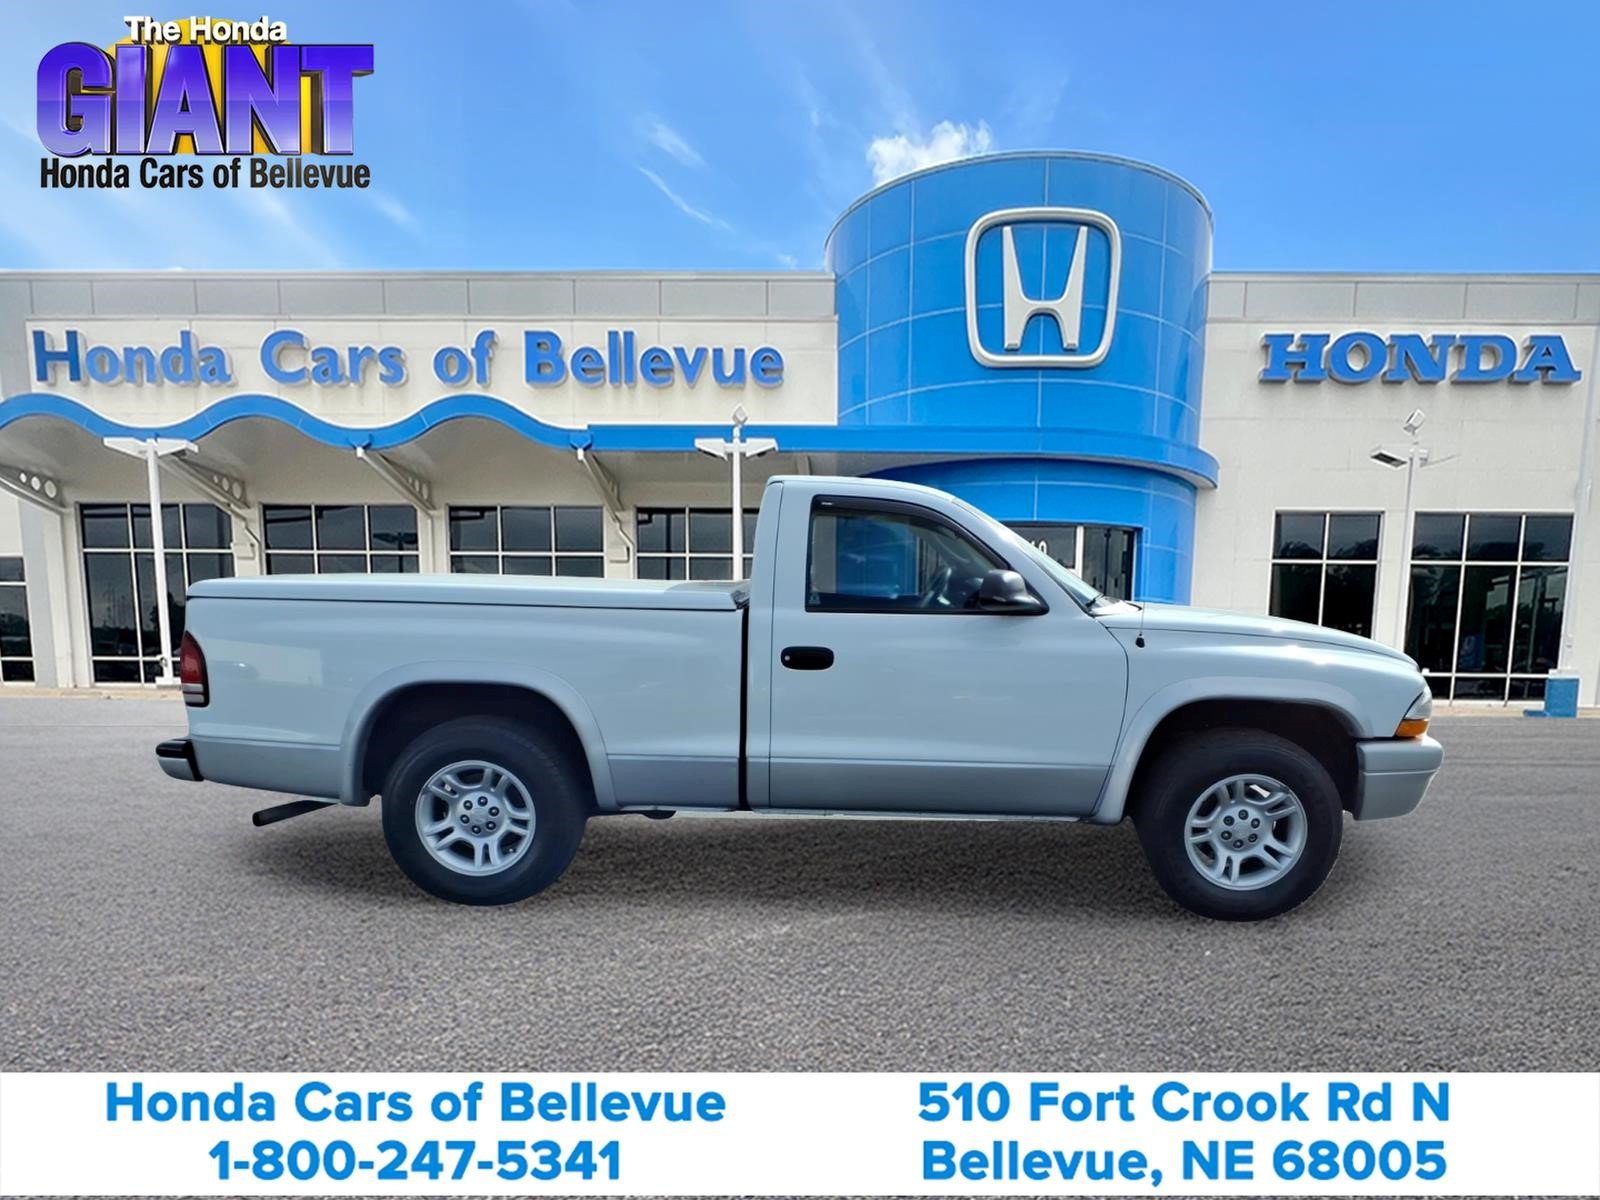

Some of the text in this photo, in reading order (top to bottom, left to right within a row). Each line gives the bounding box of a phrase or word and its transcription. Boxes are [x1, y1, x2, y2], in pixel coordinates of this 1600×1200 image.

[34, 330, 784, 387] Honda Cars of Bellevue
[1260, 331, 1582, 383] HONDA
